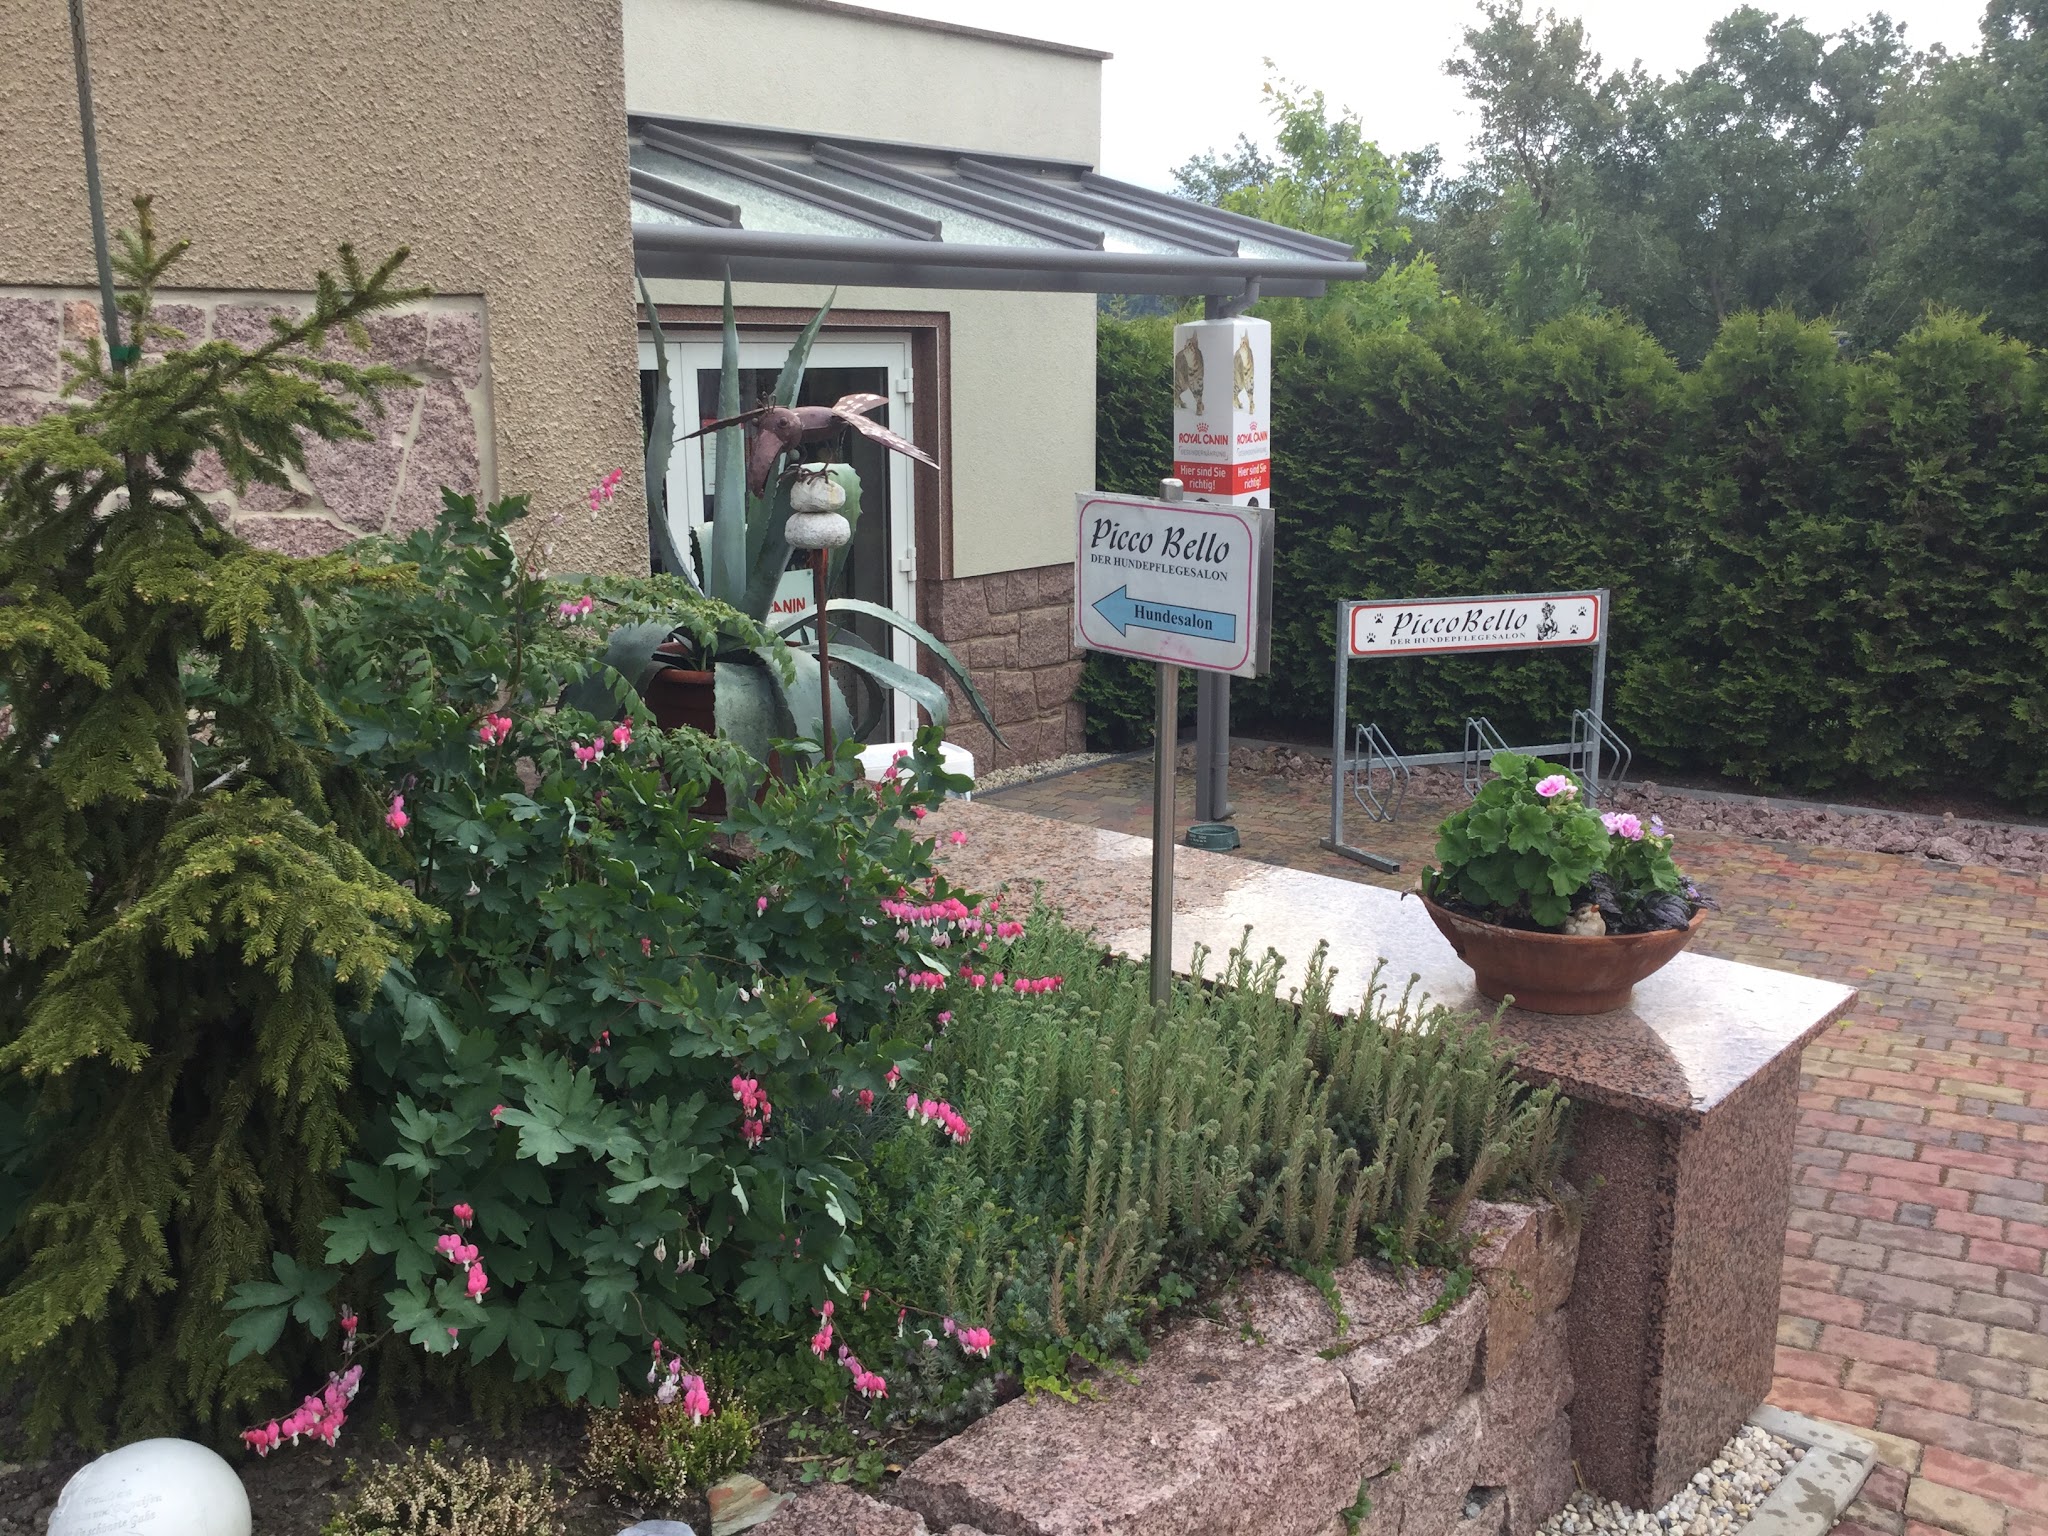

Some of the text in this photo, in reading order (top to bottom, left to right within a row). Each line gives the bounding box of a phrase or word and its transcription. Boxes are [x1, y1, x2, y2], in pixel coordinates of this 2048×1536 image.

[1178, 432, 1229, 446] ROYAL CANIN
[1180, 465, 1227, 478] Hier sind Sie
[1237, 462, 1267, 478] Hier sind Sie
[1189, 479, 1216, 492] richtig!
[1244, 476, 1262, 490] richtig!
[1091, 518, 1230, 564] Picco Bello
[1090, 553, 1229, 582] DER HUNDEPFLEGESALON
[771, 597, 806, 613] ANIN
[1133, 604, 1213, 631] Hundesalon
[1390, 632, 1526, 646] DER HUNDEPFLEGESALON
